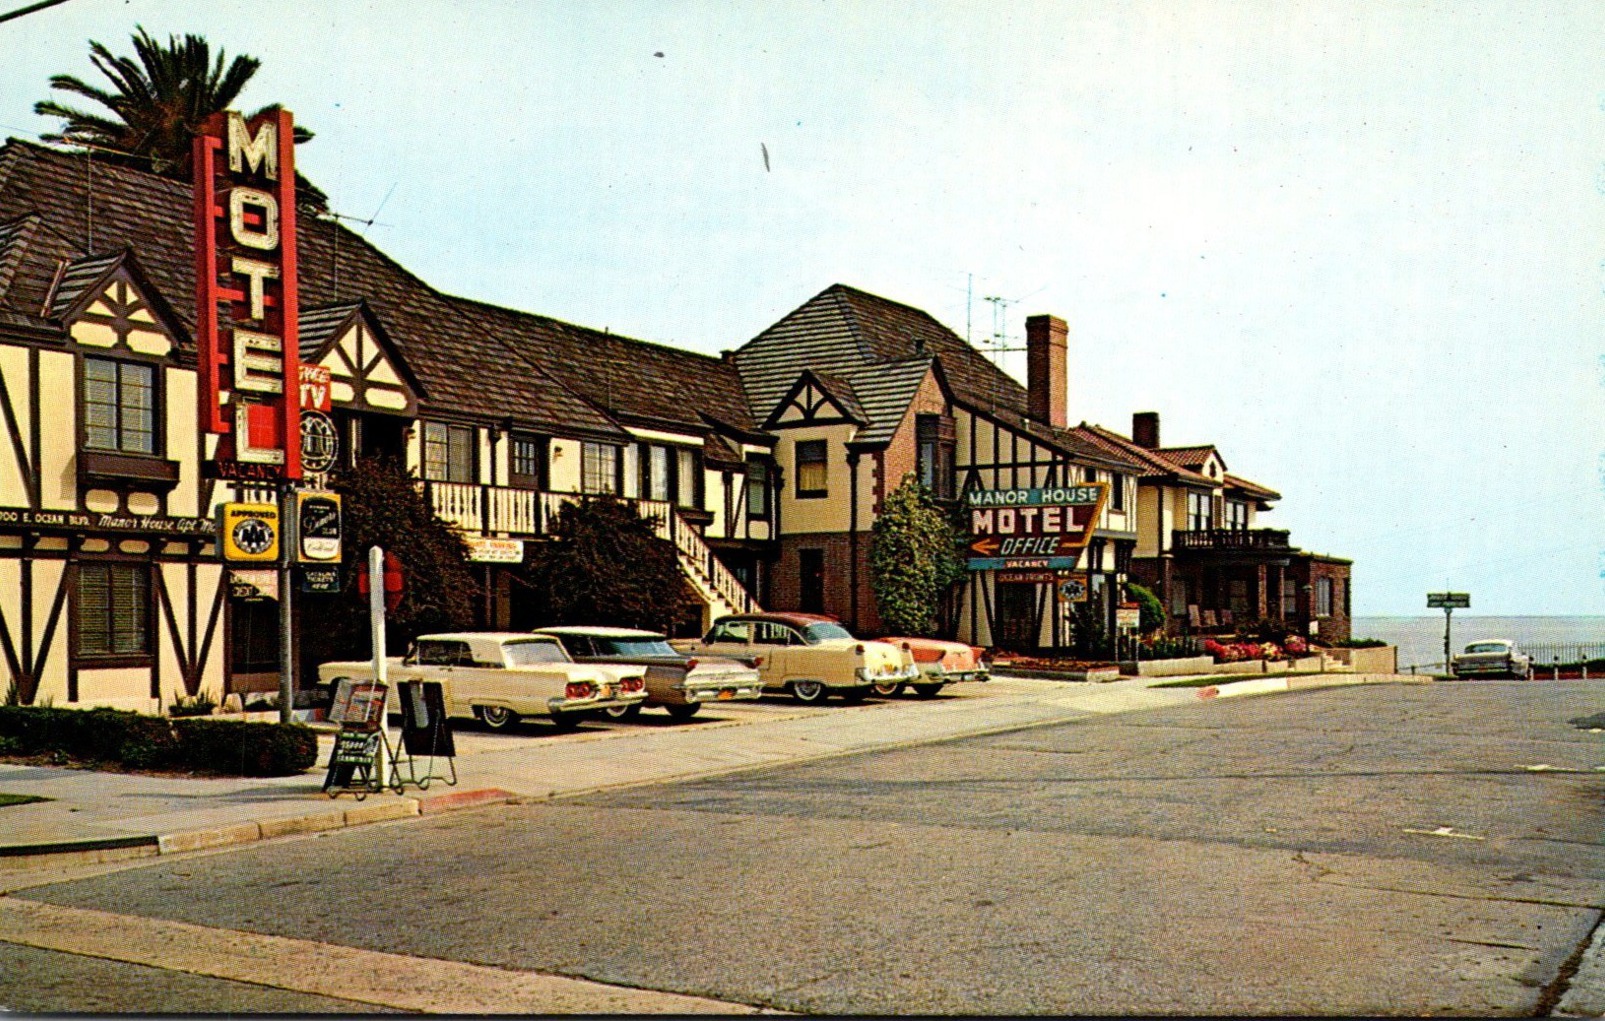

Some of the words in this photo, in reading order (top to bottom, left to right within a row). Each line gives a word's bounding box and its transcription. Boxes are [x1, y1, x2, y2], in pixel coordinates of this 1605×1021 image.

[228, 112, 285, 465] MOTEL
[299, 383, 327, 409] TV
[218, 461, 282, 480] VACANCY
[969, 490, 1028, 505] MANOR
[1042, 488, 1097, 502] HOUSE
[23, 512, 32, 523] E.
[35, 513, 64, 524] OCEAN
[98, 513, 138, 528] Manor
[140, 516, 175, 530] House
[230, 510, 277, 519] APPROVED
[972, 507, 1084, 534] MOTEL
[1001, 536, 1061, 555] OFFICE
[1005, 560, 1049, 568] VACANCY
